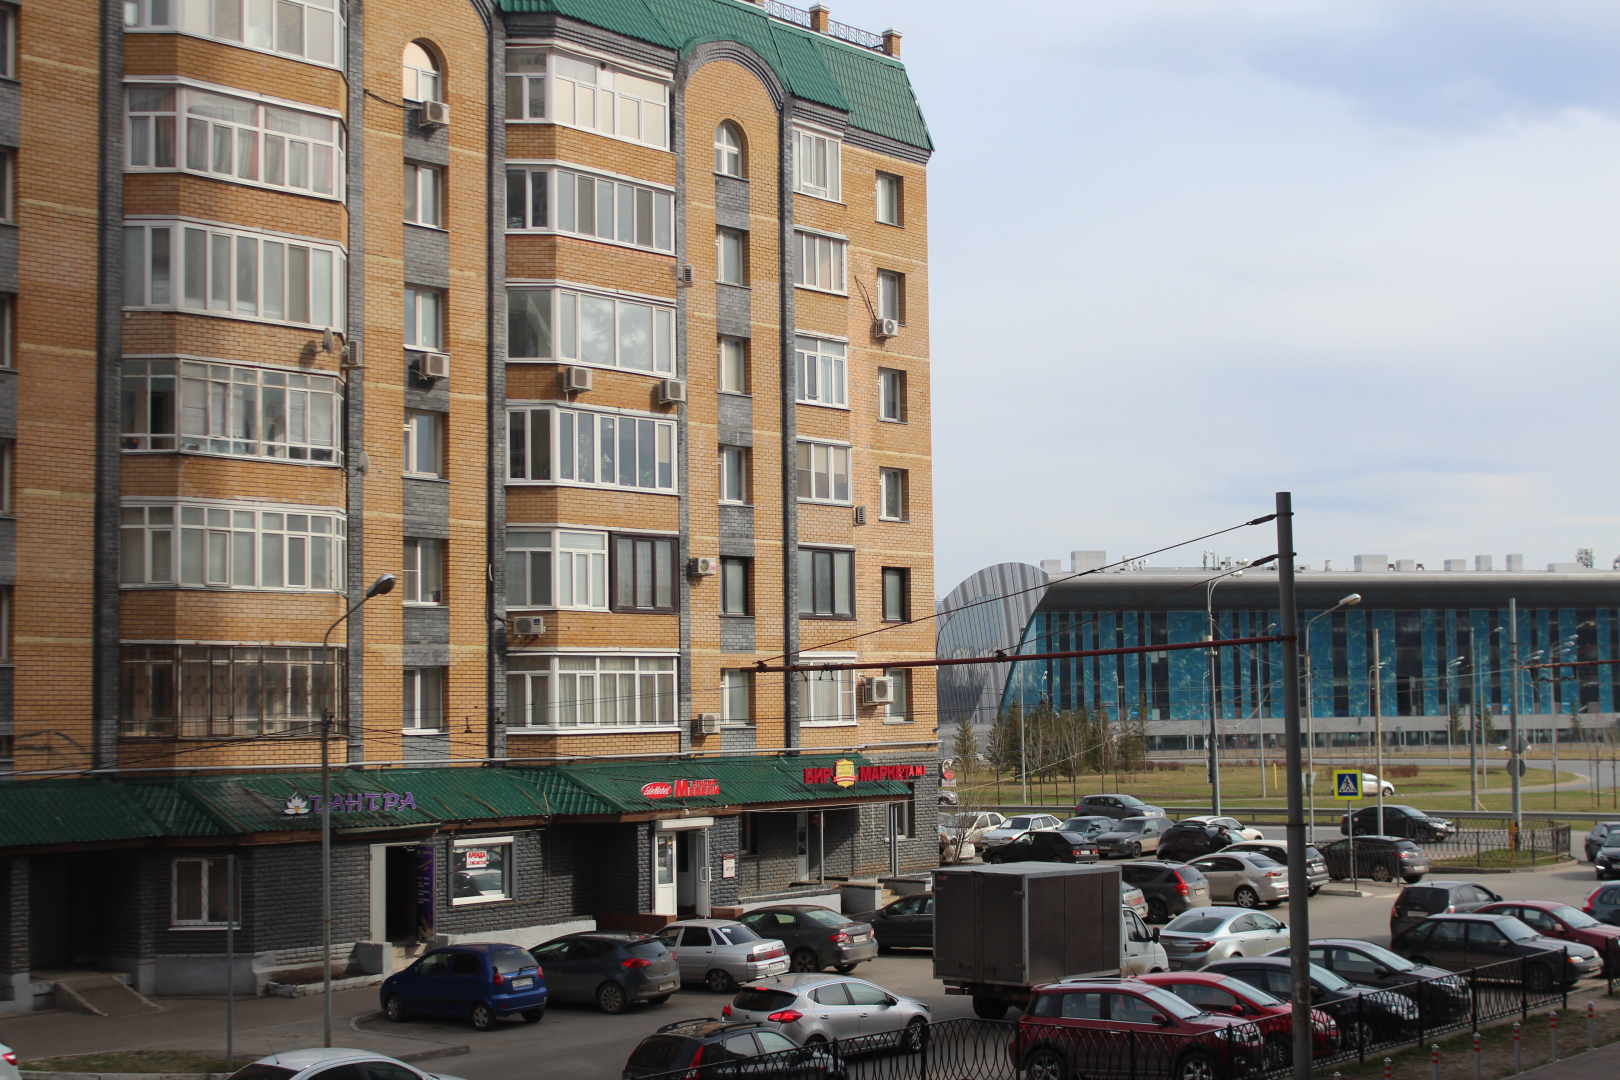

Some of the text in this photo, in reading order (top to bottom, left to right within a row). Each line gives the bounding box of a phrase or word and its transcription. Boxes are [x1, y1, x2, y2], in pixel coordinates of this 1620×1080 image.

[803, 767, 831, 784] БИР
[859, 765, 911, 782] МАРКЕТ
[674, 779, 720, 798] МЕБЕЛИ
[308, 791, 417, 813] ТАНТРА
